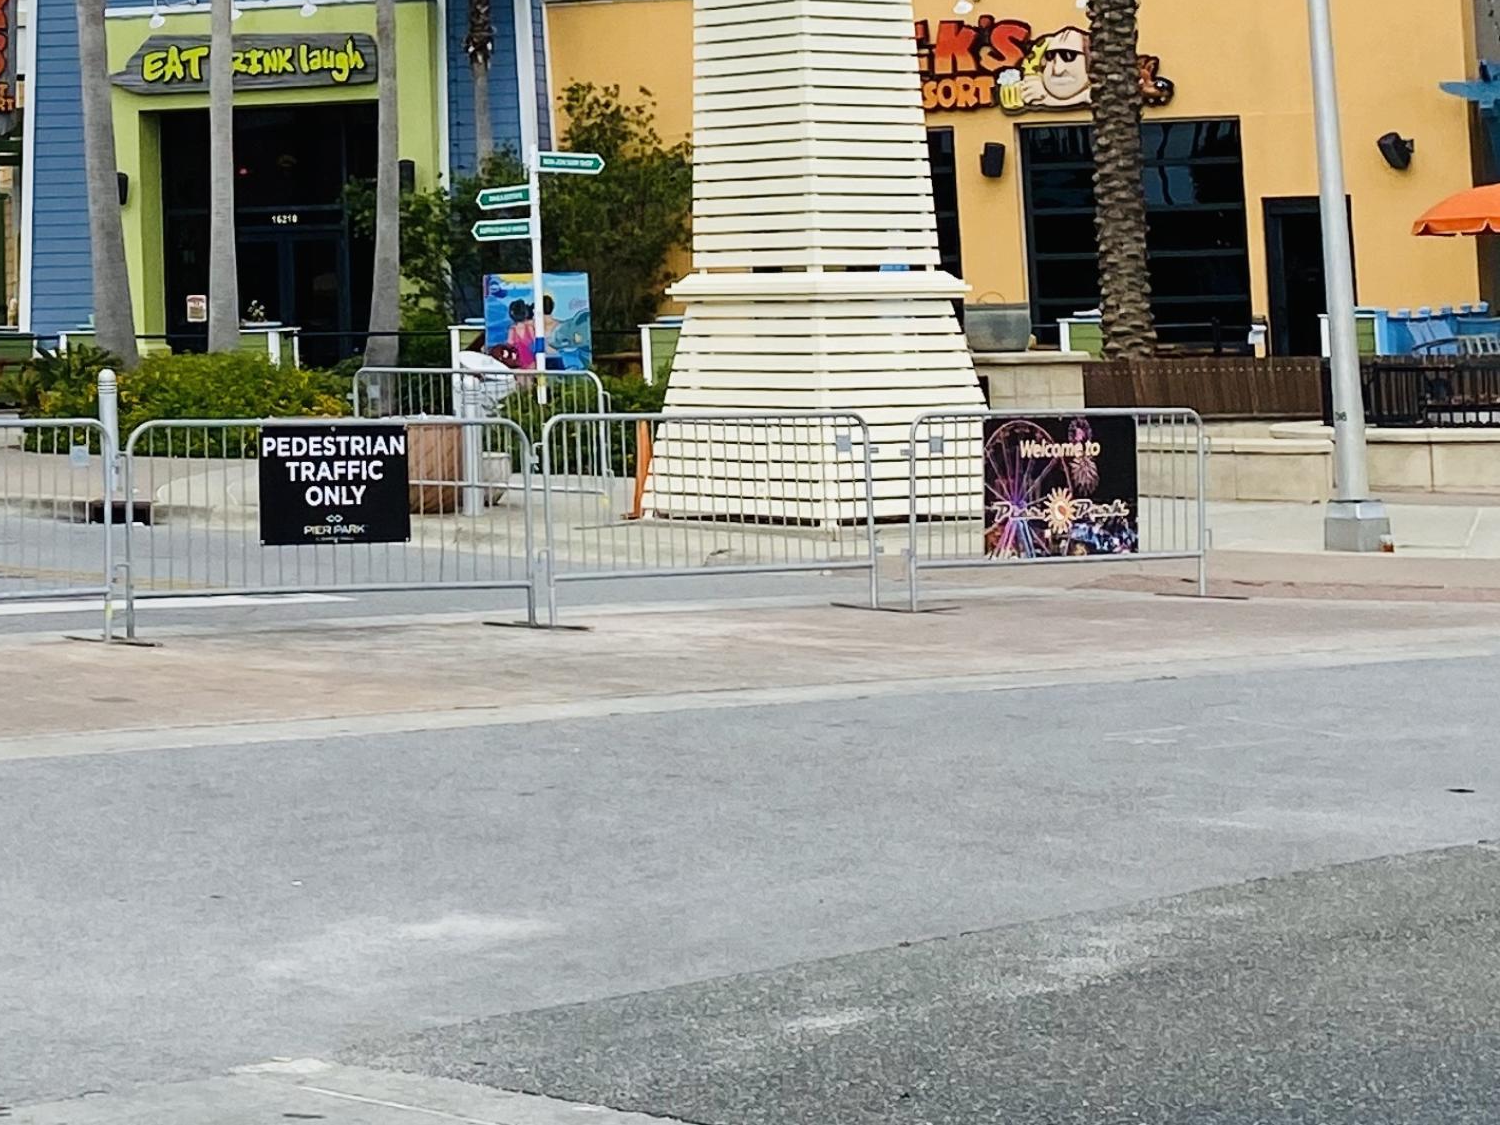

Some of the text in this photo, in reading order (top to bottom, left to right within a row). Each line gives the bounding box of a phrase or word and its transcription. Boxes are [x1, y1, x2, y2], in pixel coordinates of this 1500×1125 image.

[141, 36, 365, 84] EAT RINK laugh
[923, 75, 995, 110] SORT
[262, 435, 405, 458] PEDESTRIAN
[1019, 439, 1101, 459] Welcome to
[285, 460, 383, 482] TRAFFIC
[304, 485, 367, 507] ONLY
[303, 524, 365, 535] PIER PARK
